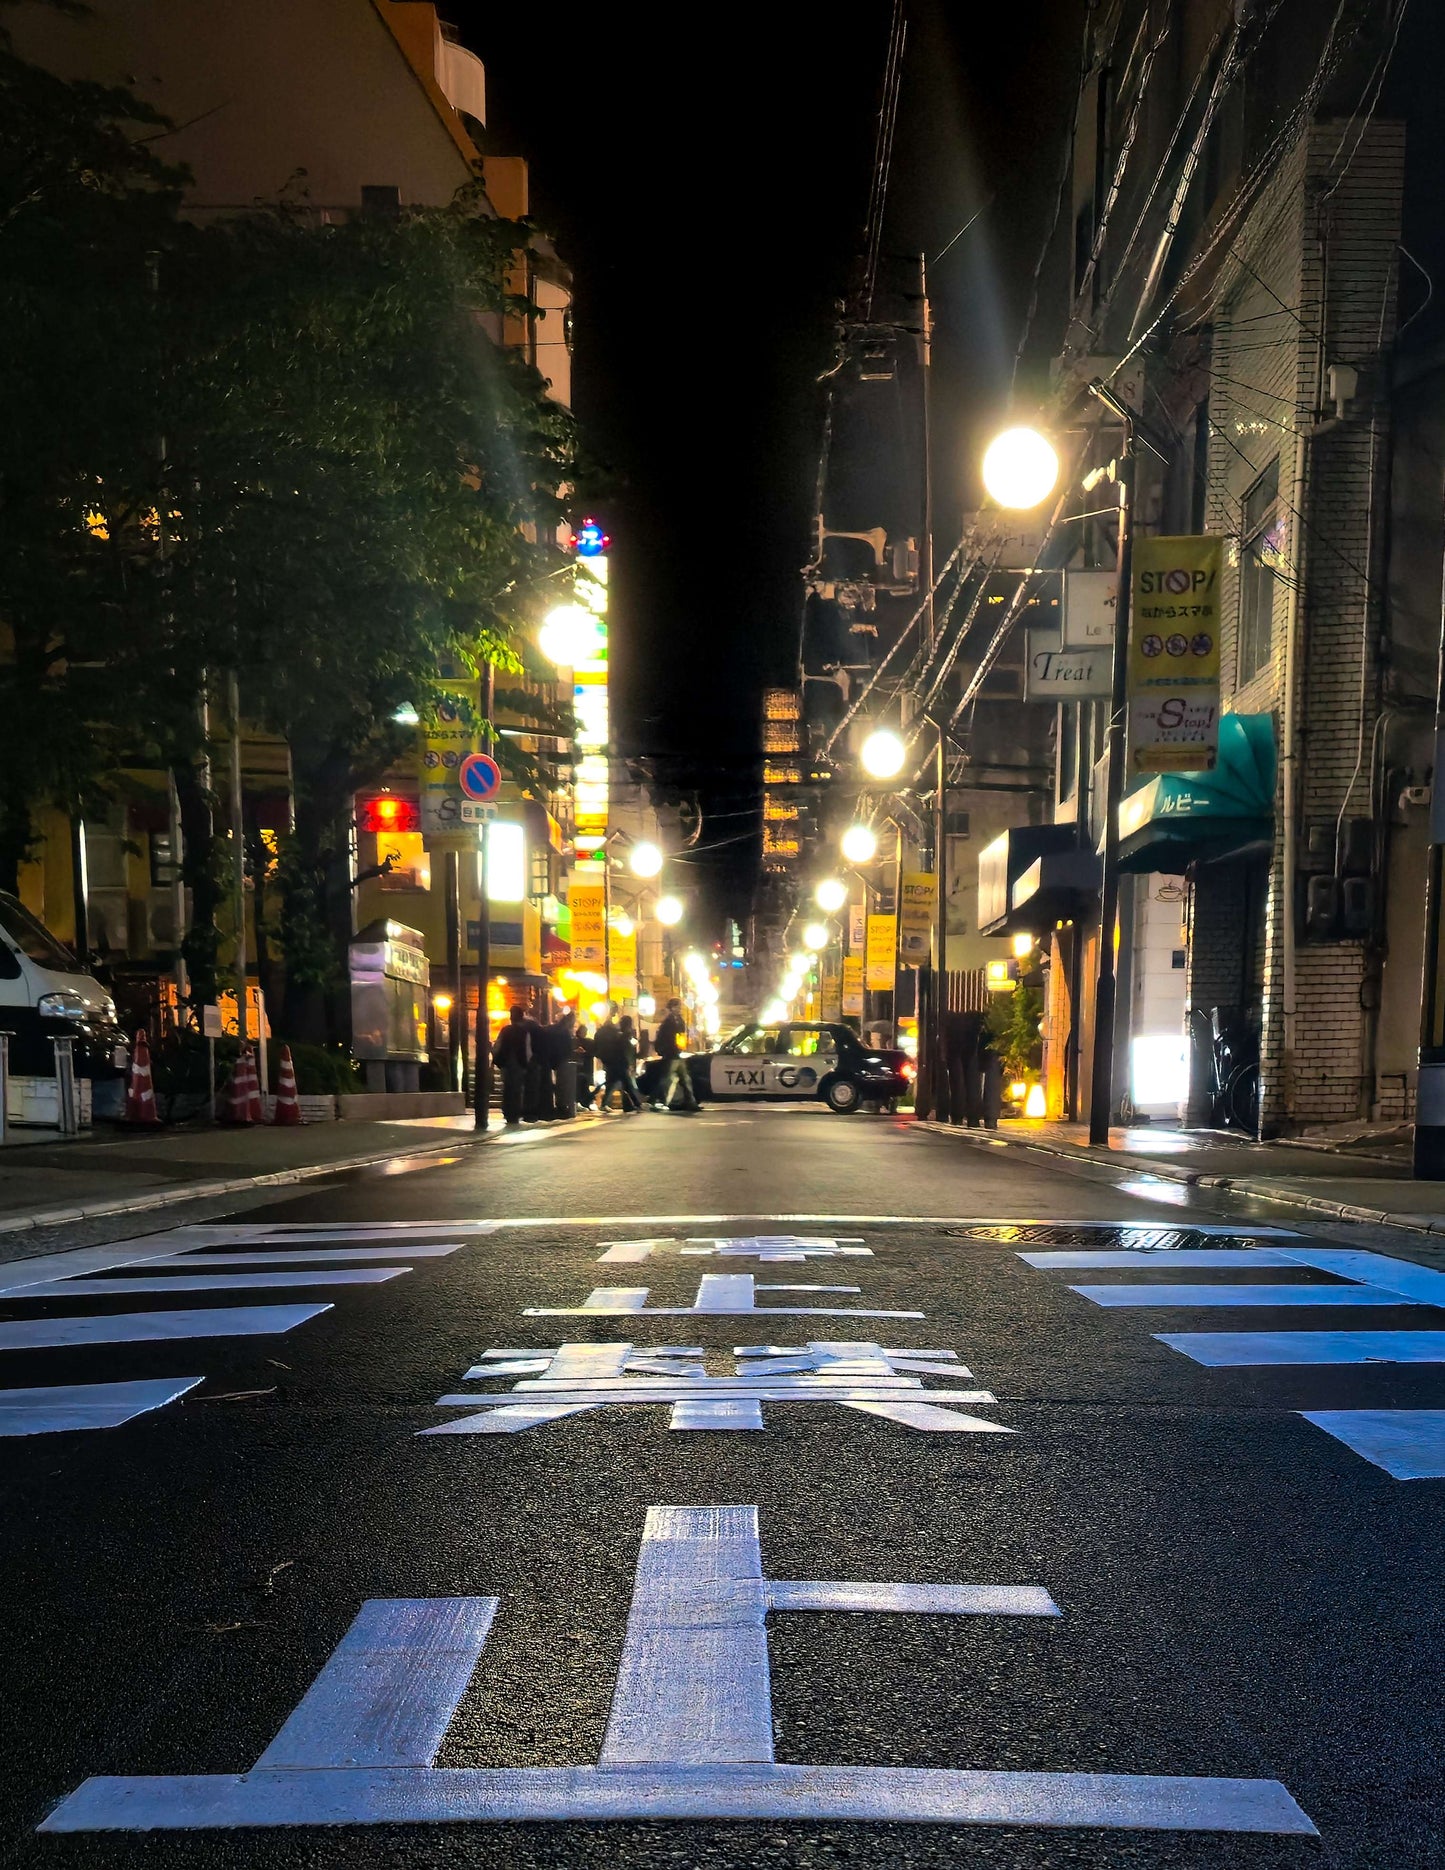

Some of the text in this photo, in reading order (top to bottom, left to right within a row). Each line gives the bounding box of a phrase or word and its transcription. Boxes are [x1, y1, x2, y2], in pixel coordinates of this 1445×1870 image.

[1033, 652, 1094, 681] Treat
[1160, 793, 1210, 814] ルビー
[724, 1070, 766, 1086] TAXI
